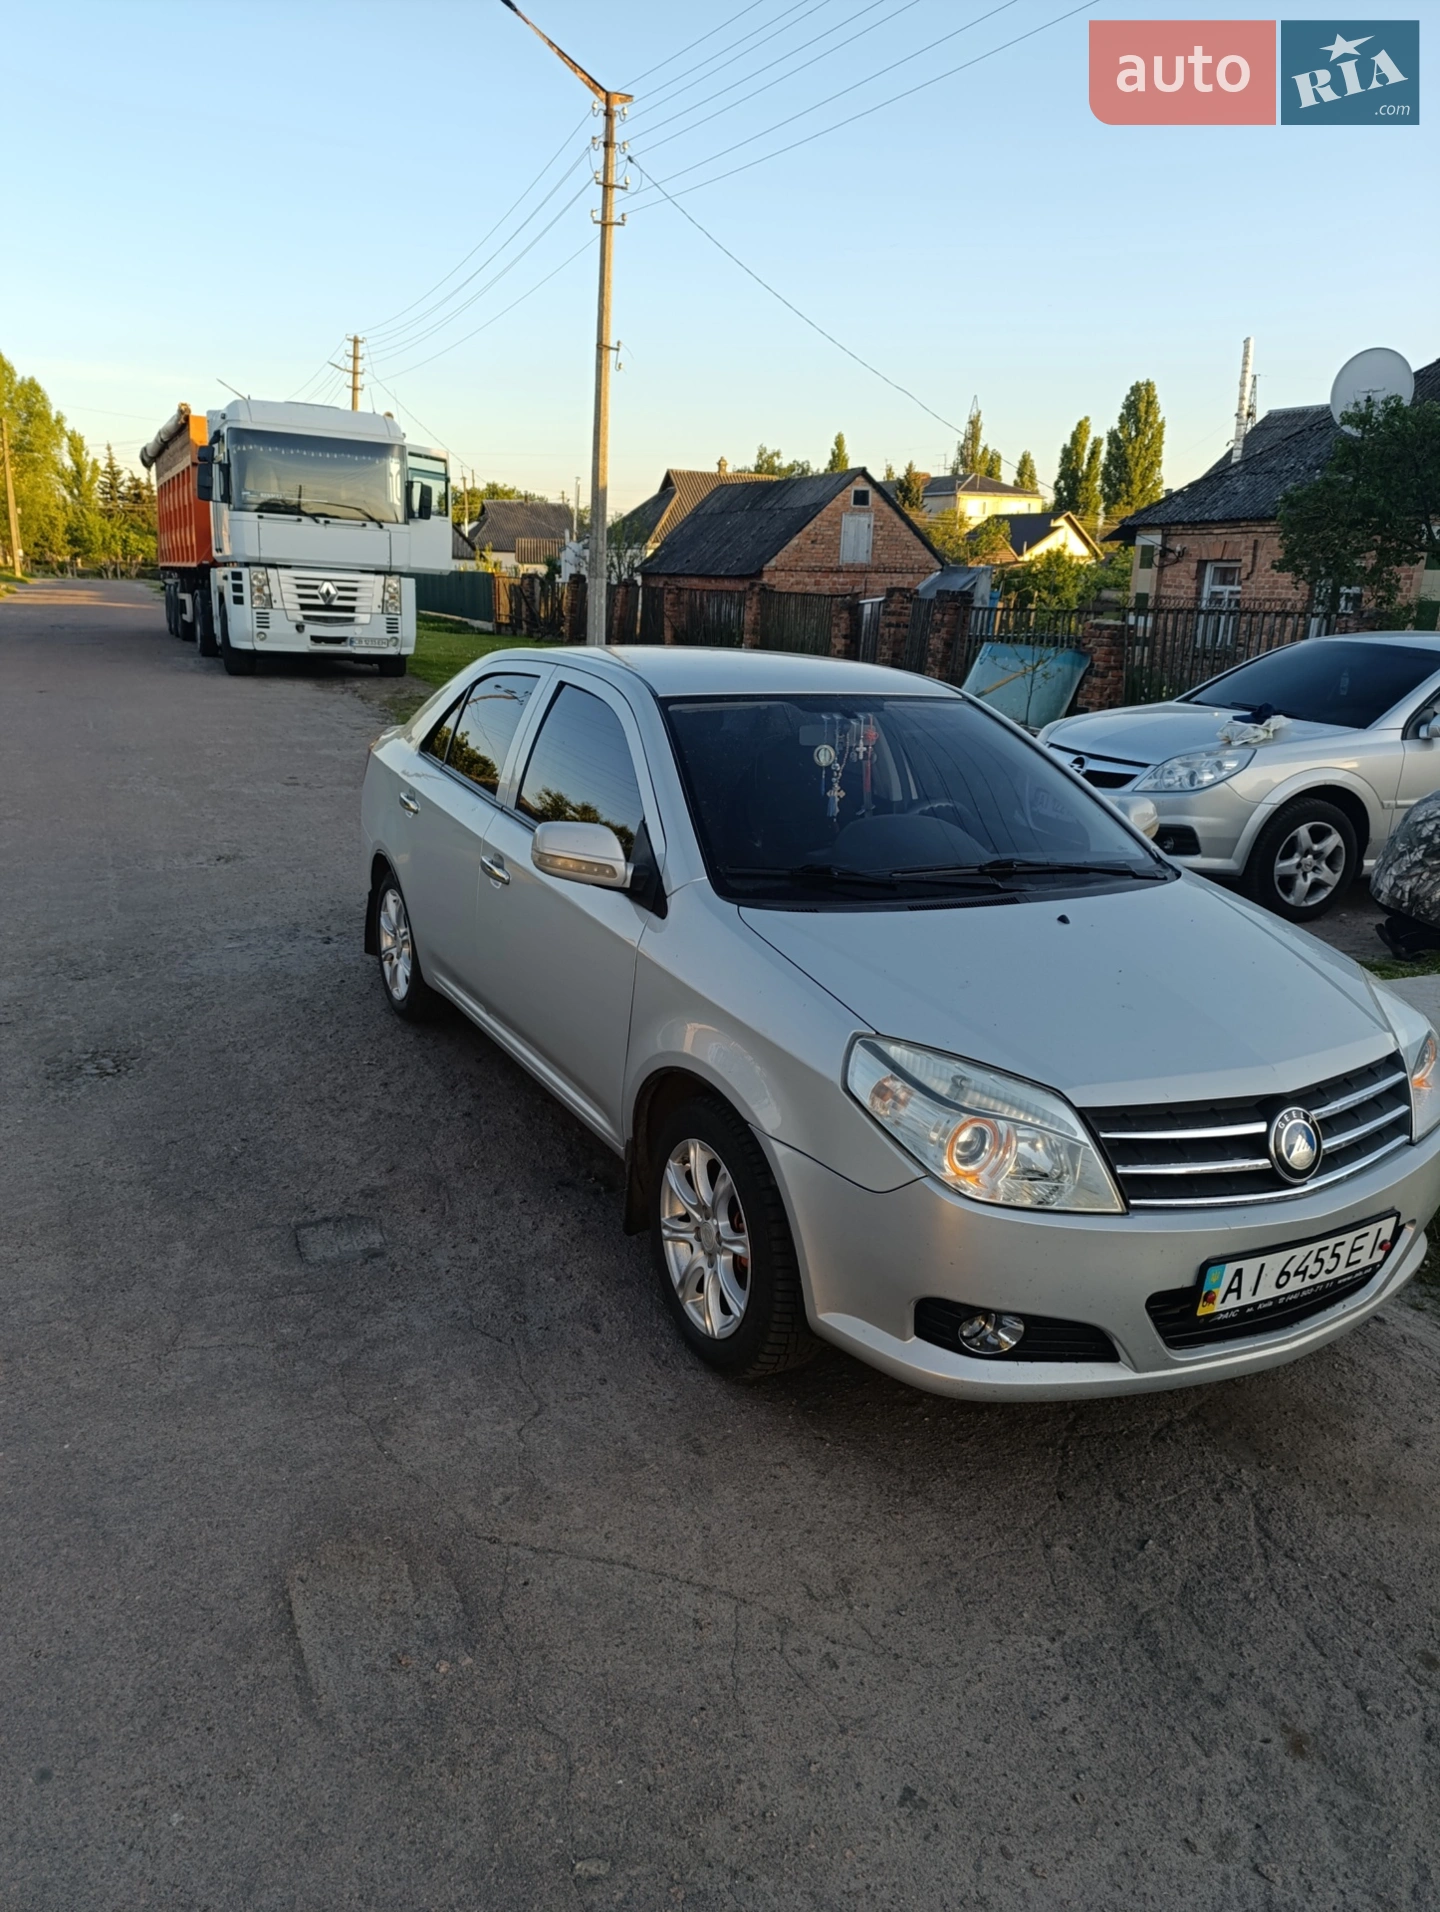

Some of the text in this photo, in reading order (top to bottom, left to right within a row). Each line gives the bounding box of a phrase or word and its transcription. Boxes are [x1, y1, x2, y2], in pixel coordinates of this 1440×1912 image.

[1219, 1227, 1382, 1304] AI 6455 EI
